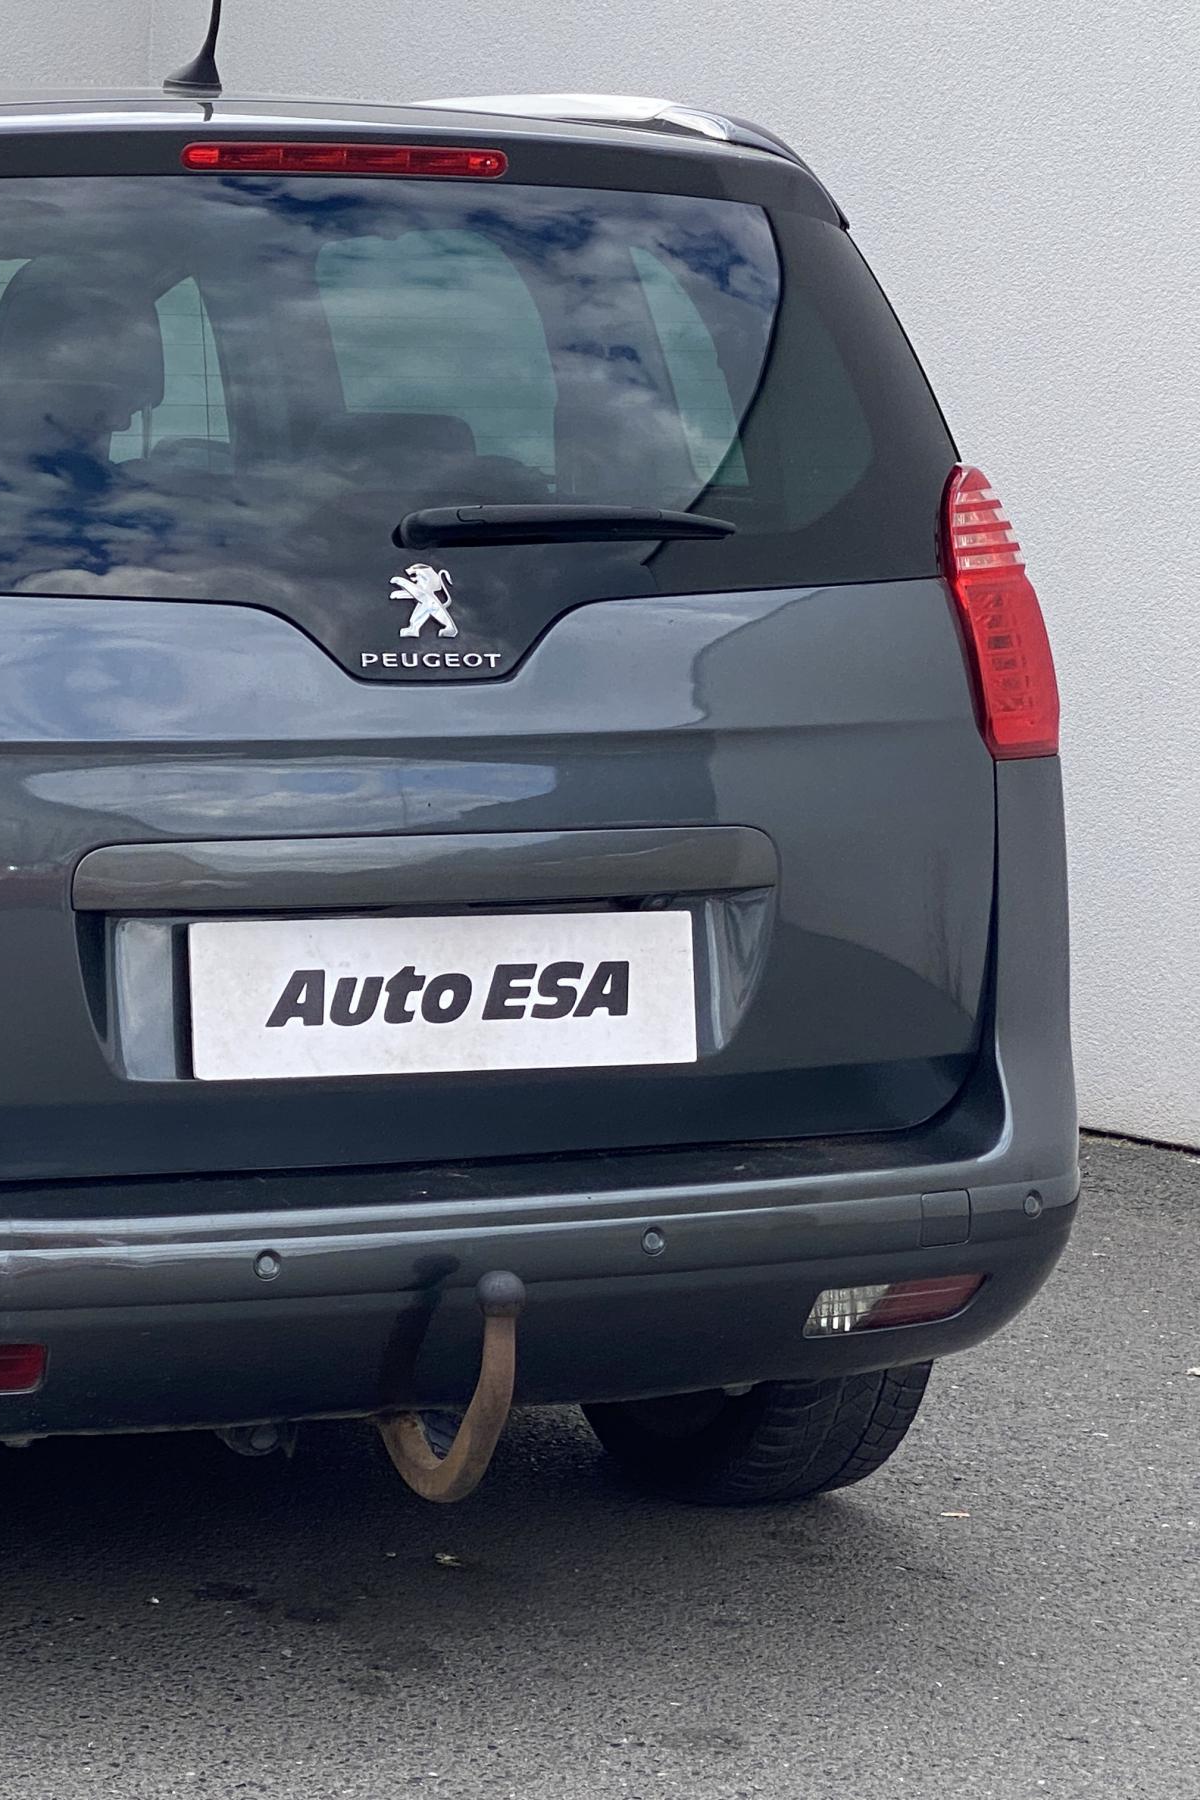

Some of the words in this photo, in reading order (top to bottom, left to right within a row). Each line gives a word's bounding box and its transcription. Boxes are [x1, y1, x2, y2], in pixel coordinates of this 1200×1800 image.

[361, 653, 502, 668] PEUGEOT
[265, 966, 473, 1028] Auto
[481, 961, 630, 1020] ESA
